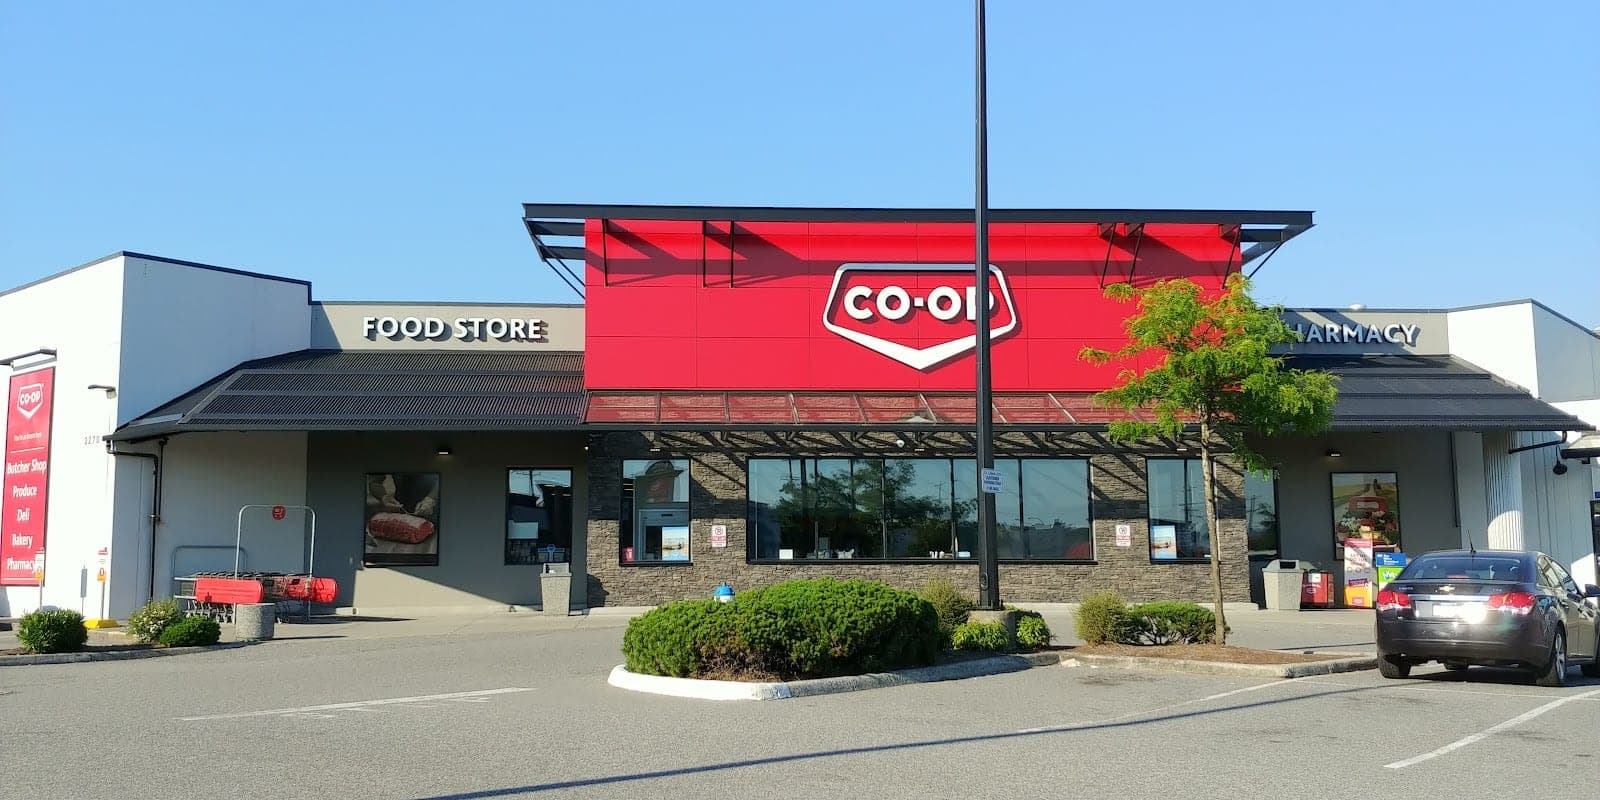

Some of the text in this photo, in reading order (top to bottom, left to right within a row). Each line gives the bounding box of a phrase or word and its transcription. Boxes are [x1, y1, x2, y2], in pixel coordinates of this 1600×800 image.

[843, 285, 995, 321] CO-OP
[363, 316, 543, 339] FOOD STORE
[1284, 323, 1417, 343] HARMACY
[20, 390, 41, 406] CO-OP
[7, 458, 47, 475] Butcher Shop
[12, 484, 38, 498] Produce
[17, 507, 31, 522] Deli
[12, 533, 33, 550] Bakery
[7, 556, 36, 574] Pharmacy
